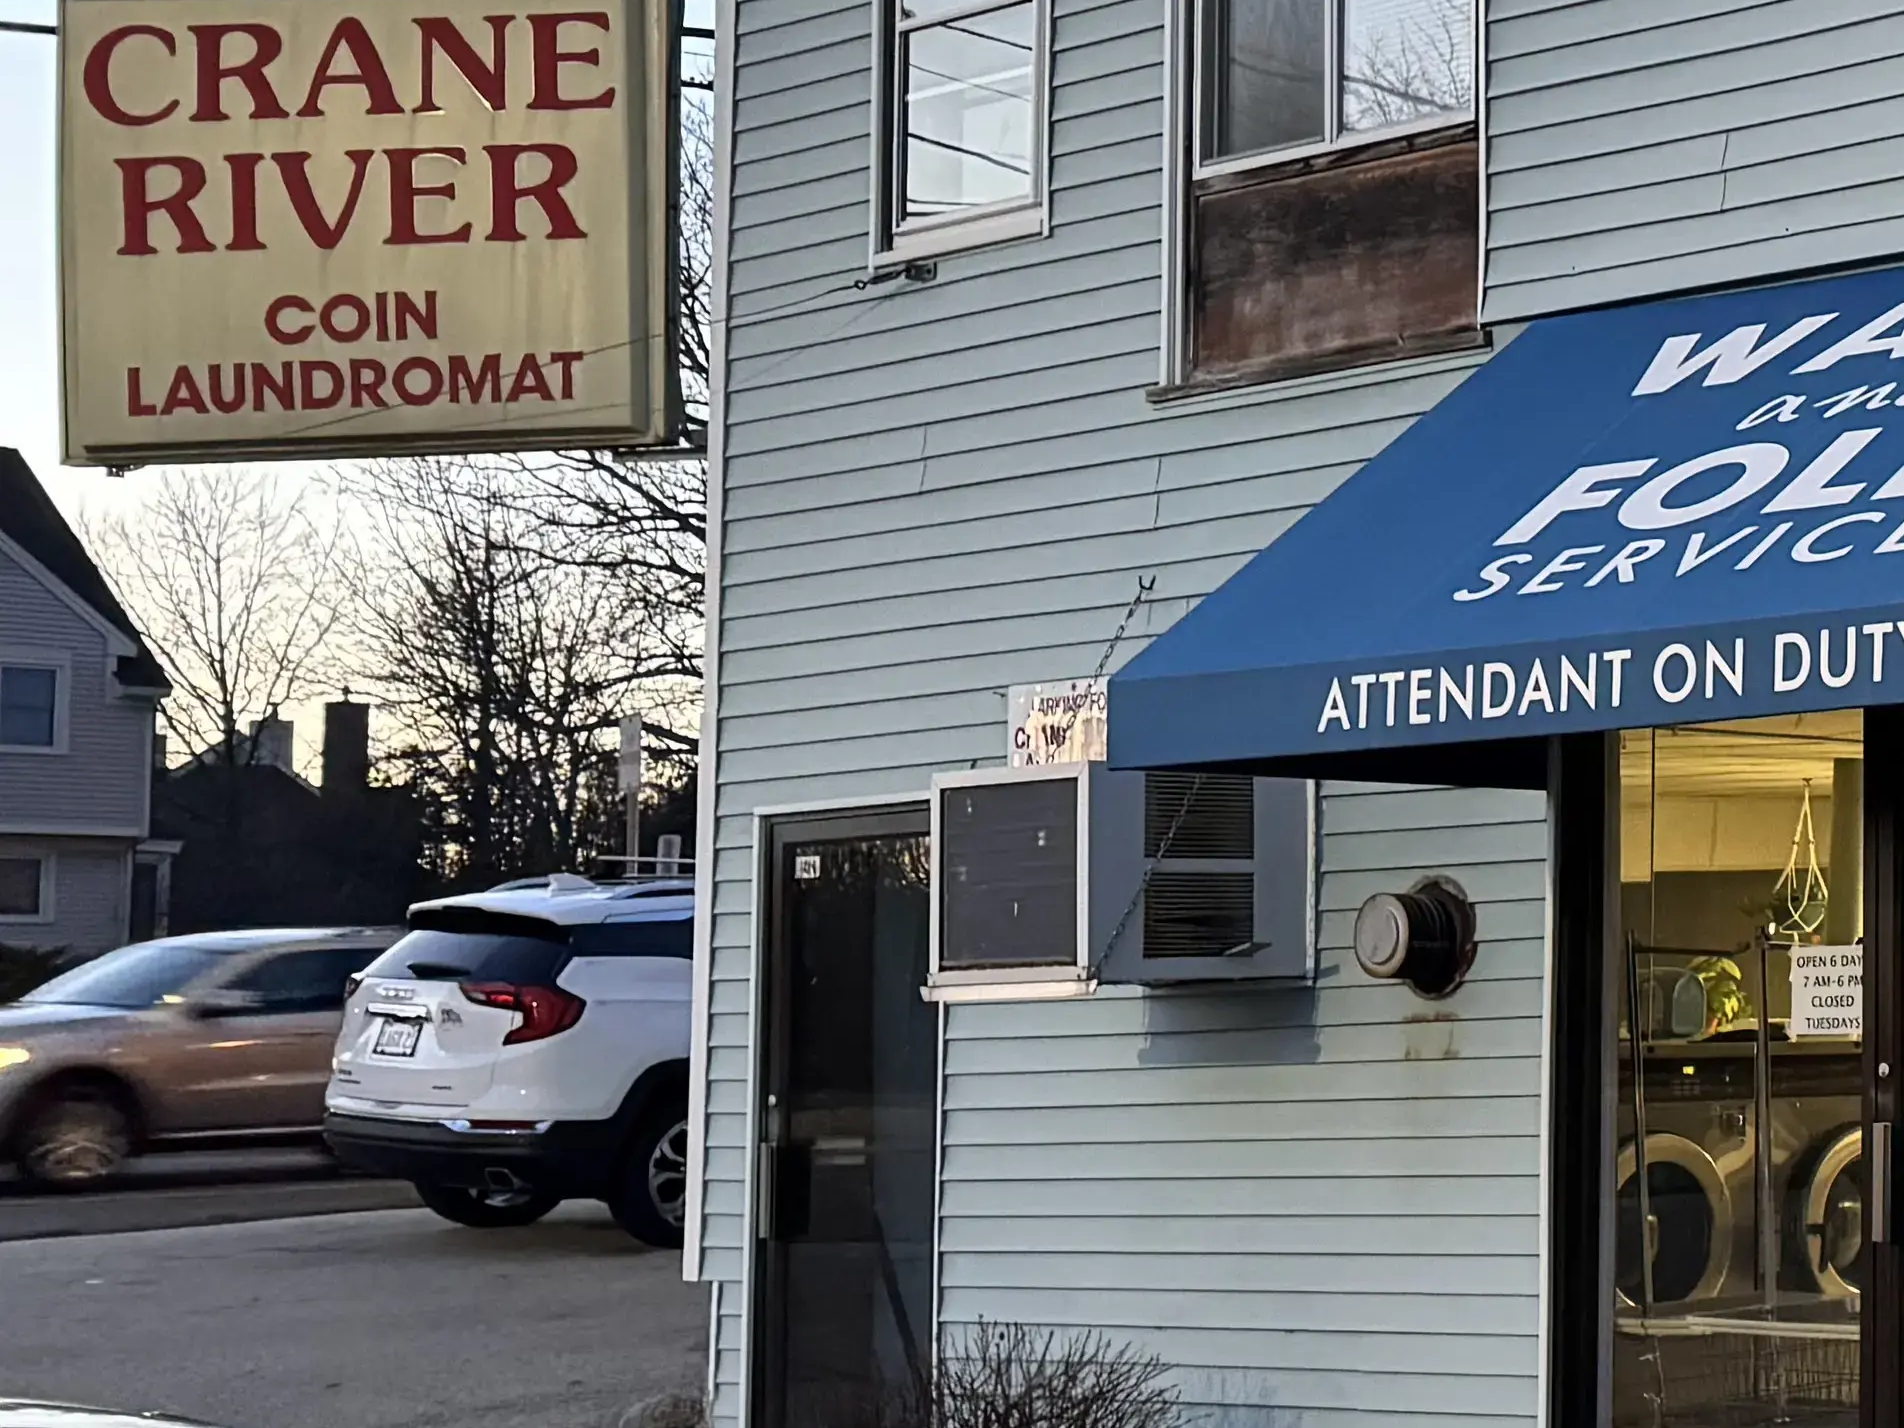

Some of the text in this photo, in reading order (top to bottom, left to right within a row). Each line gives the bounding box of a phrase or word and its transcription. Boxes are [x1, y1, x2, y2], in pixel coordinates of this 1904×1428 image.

[83, 11, 616, 127] CRANE
[113, 143, 588, 256] RIVER
[264, 290, 438, 345] COIN
[127, 351, 585, 417] LAUNDROMAT
[1317, 648, 1632, 733] ATTENDANT
[1653, 637, 1745, 704] ON
[1796, 955, 1827, 968] OPEN
[1830, 954, 1837, 967] 6
[1803, 976, 1810, 988] 7
[1805, 1016, 1861, 1030] TUESDAYS
[1811, 995, 1855, 1008] CLOSED
